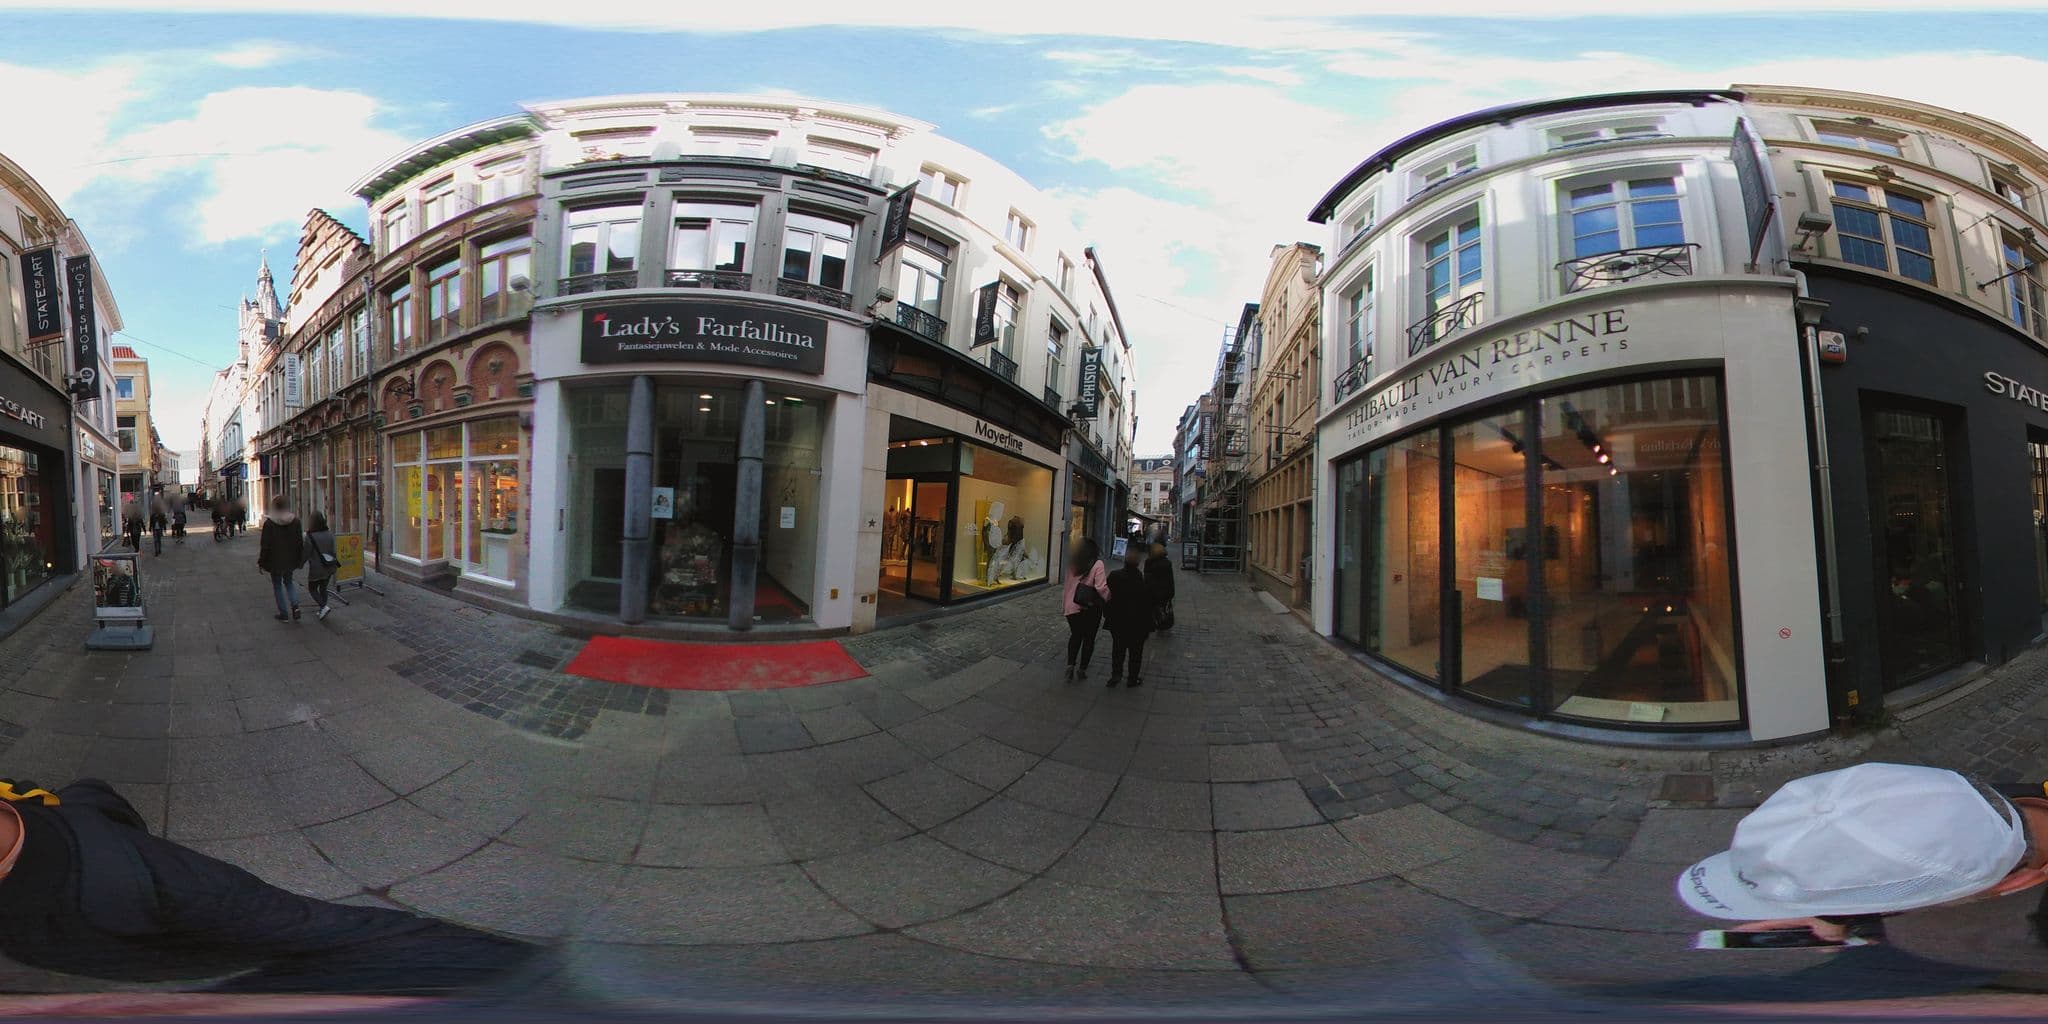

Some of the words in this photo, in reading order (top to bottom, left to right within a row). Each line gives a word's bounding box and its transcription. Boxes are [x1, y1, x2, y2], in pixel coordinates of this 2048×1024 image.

[32, 256, 44, 277] ART
[71, 262, 87, 273] THE
[34, 279, 41, 290] OF
[74, 273, 86, 311] OTHER
[35, 289, 49, 330] STATE
[79, 314, 90, 354] SHOP
[600, 316, 680, 339] Lady's
[696, 316, 815, 349] Farfallina
[618, 341, 694, 351] Fantasiejuwelen
[696, 342, 705, 350] &
[710, 342, 740, 353] Mode
[742, 345, 799, 361] Accessoires
[1346, 373, 1424, 430] THIBAULT
[1428, 347, 1482, 387] VAN
[1491, 308, 1629, 365] RENNE
[1348, 402, 1417, 440] TAILOR-MADE
[1427, 372, 1494, 404] LUXURY
[1512, 339, 1629, 374] CARPETS
[1984, 371, 2048, 412] STATE
[7, 400, 18, 413] OF
[20, 407, 47, 430] ART
[974, 419, 1024, 451] Mayerline
